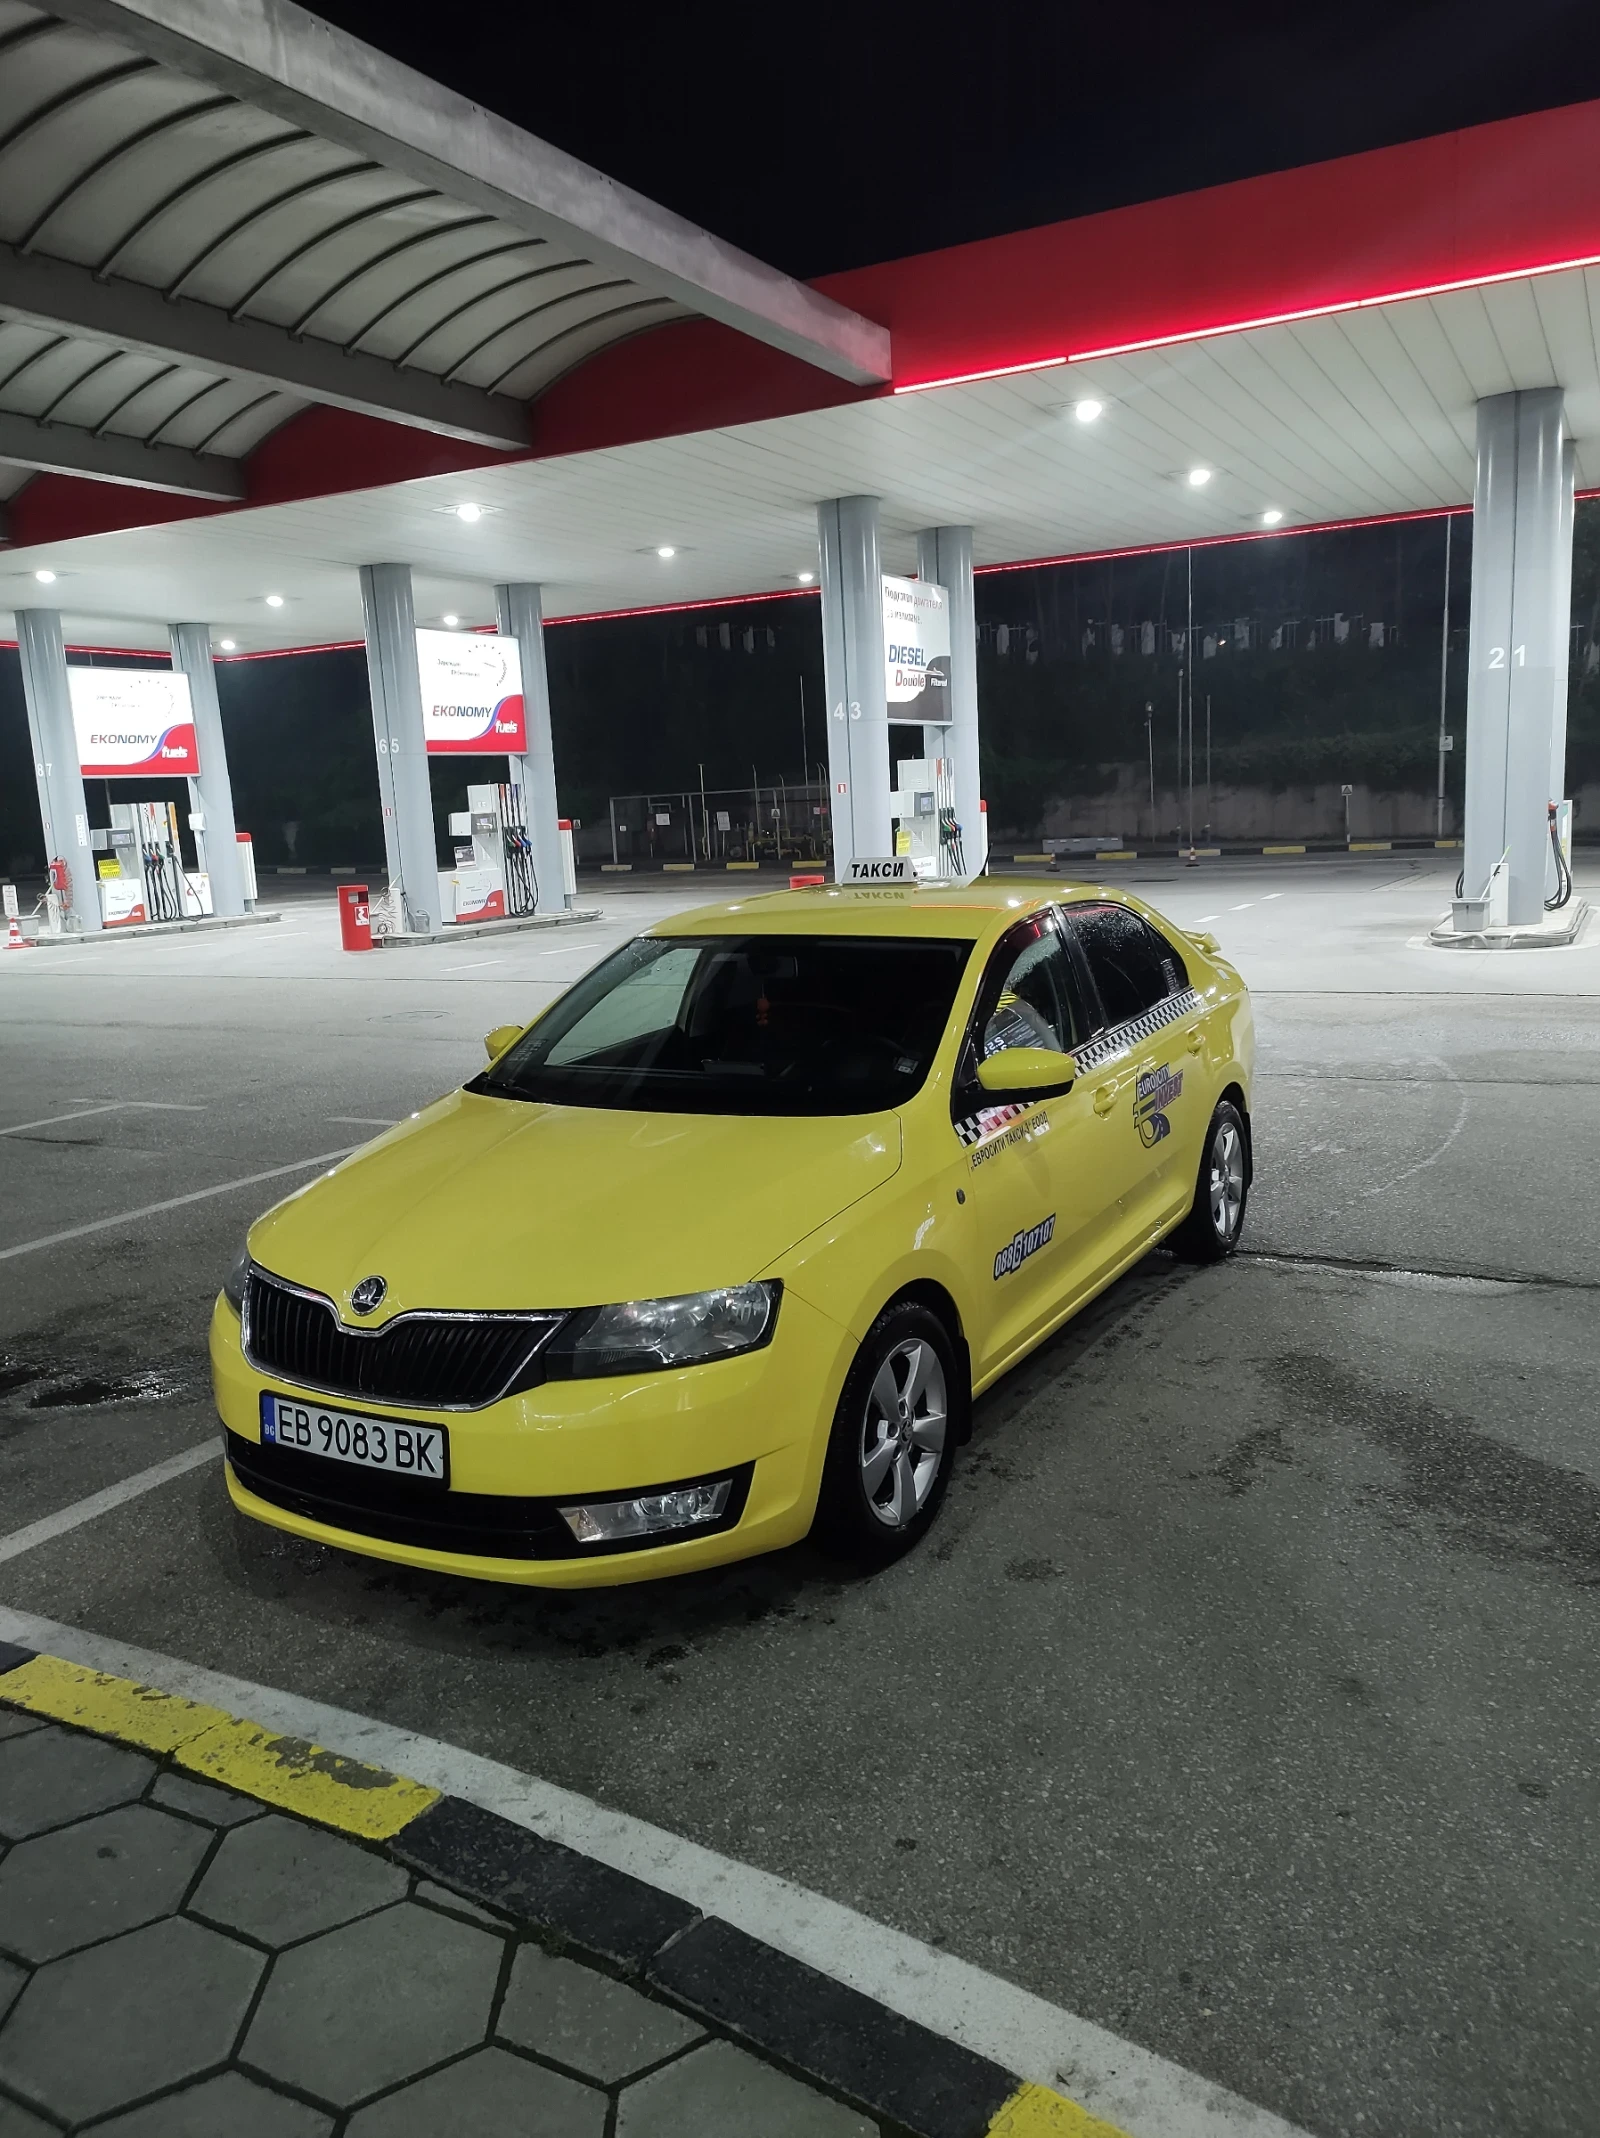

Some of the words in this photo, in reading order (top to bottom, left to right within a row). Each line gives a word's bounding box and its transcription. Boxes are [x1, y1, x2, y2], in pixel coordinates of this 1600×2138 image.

[888, 644, 927, 667] DIESEL
[1488, 647, 1505, 669] 2
[1513, 645, 1527, 667] 1
[895, 669, 926, 688] Double
[432, 704, 492, 718] EKONOMY
[833, 702, 845, 721] 4
[850, 701, 862, 720] 3
[495, 720, 518, 734] fuels
[90, 734, 158, 744] EKONOMY
[379, 738, 388, 754] 6
[391, 738, 400, 754] 5
[161, 746, 188, 759] fuels
[37, 763, 45, 777] 8
[46, 763, 53, 777] 7
[851, 862, 904, 878] ТАКСИ
[1032, 1110, 1049, 1130] ЕООД
[994, 1214, 1055, 1279] 0886107107
[264, 1423, 275, 1436] BG
[278, 1403, 312, 1447] EB
[317, 1414, 388, 1463] 9083
[394, 1428, 438, 1474] BK
